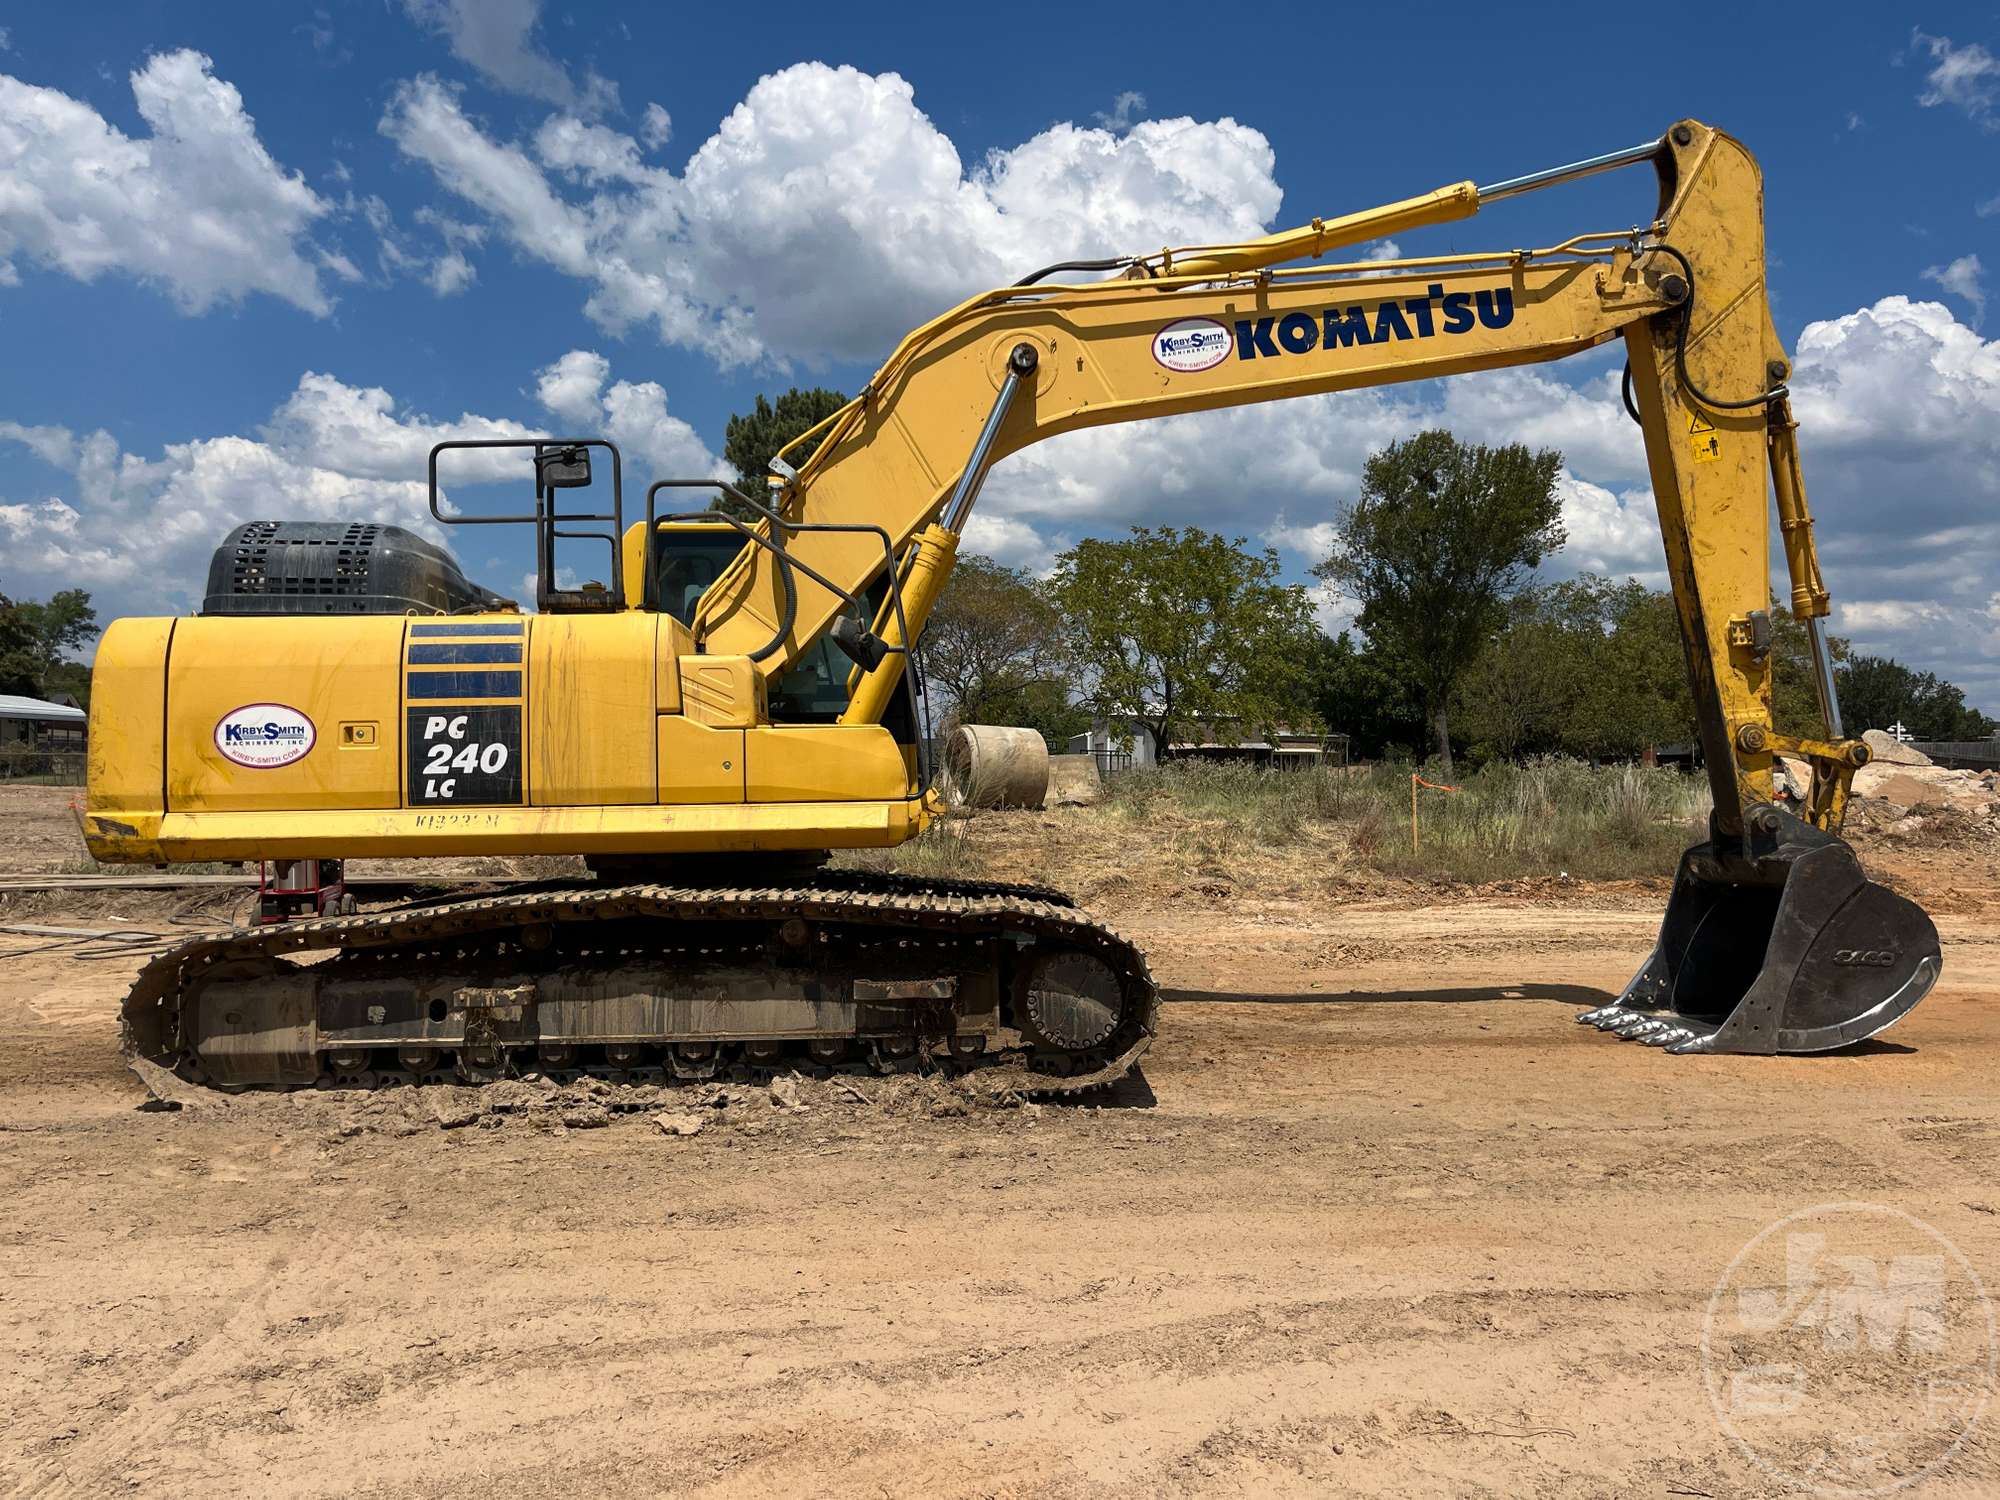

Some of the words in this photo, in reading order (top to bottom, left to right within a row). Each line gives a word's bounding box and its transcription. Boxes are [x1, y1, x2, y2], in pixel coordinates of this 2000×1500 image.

[1235, 284, 1514, 360] KOMATSU
[225, 722, 305, 741] KIRBY-SMITH
[424, 715, 469, 740] PC
[422, 742, 509, 775] 240
[424, 778, 456, 798] LC
